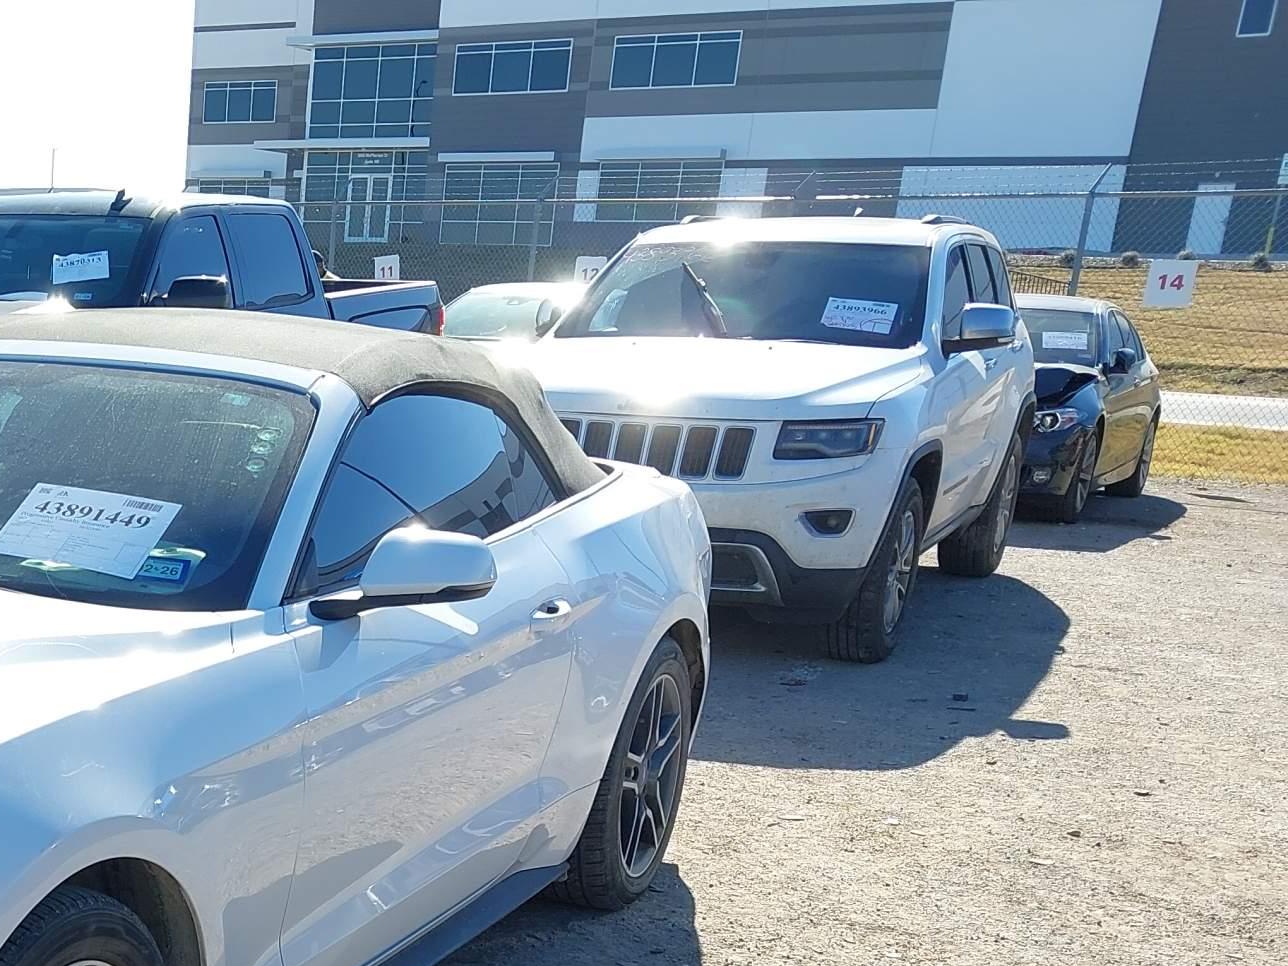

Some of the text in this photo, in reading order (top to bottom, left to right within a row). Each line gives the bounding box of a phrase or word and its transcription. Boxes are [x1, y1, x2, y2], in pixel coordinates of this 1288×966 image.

[379, 266, 393, 278] 11
[582, 267, 599, 281] 12
[1158, 274, 1184, 290] 14
[34, 500, 151, 529] 43891449
